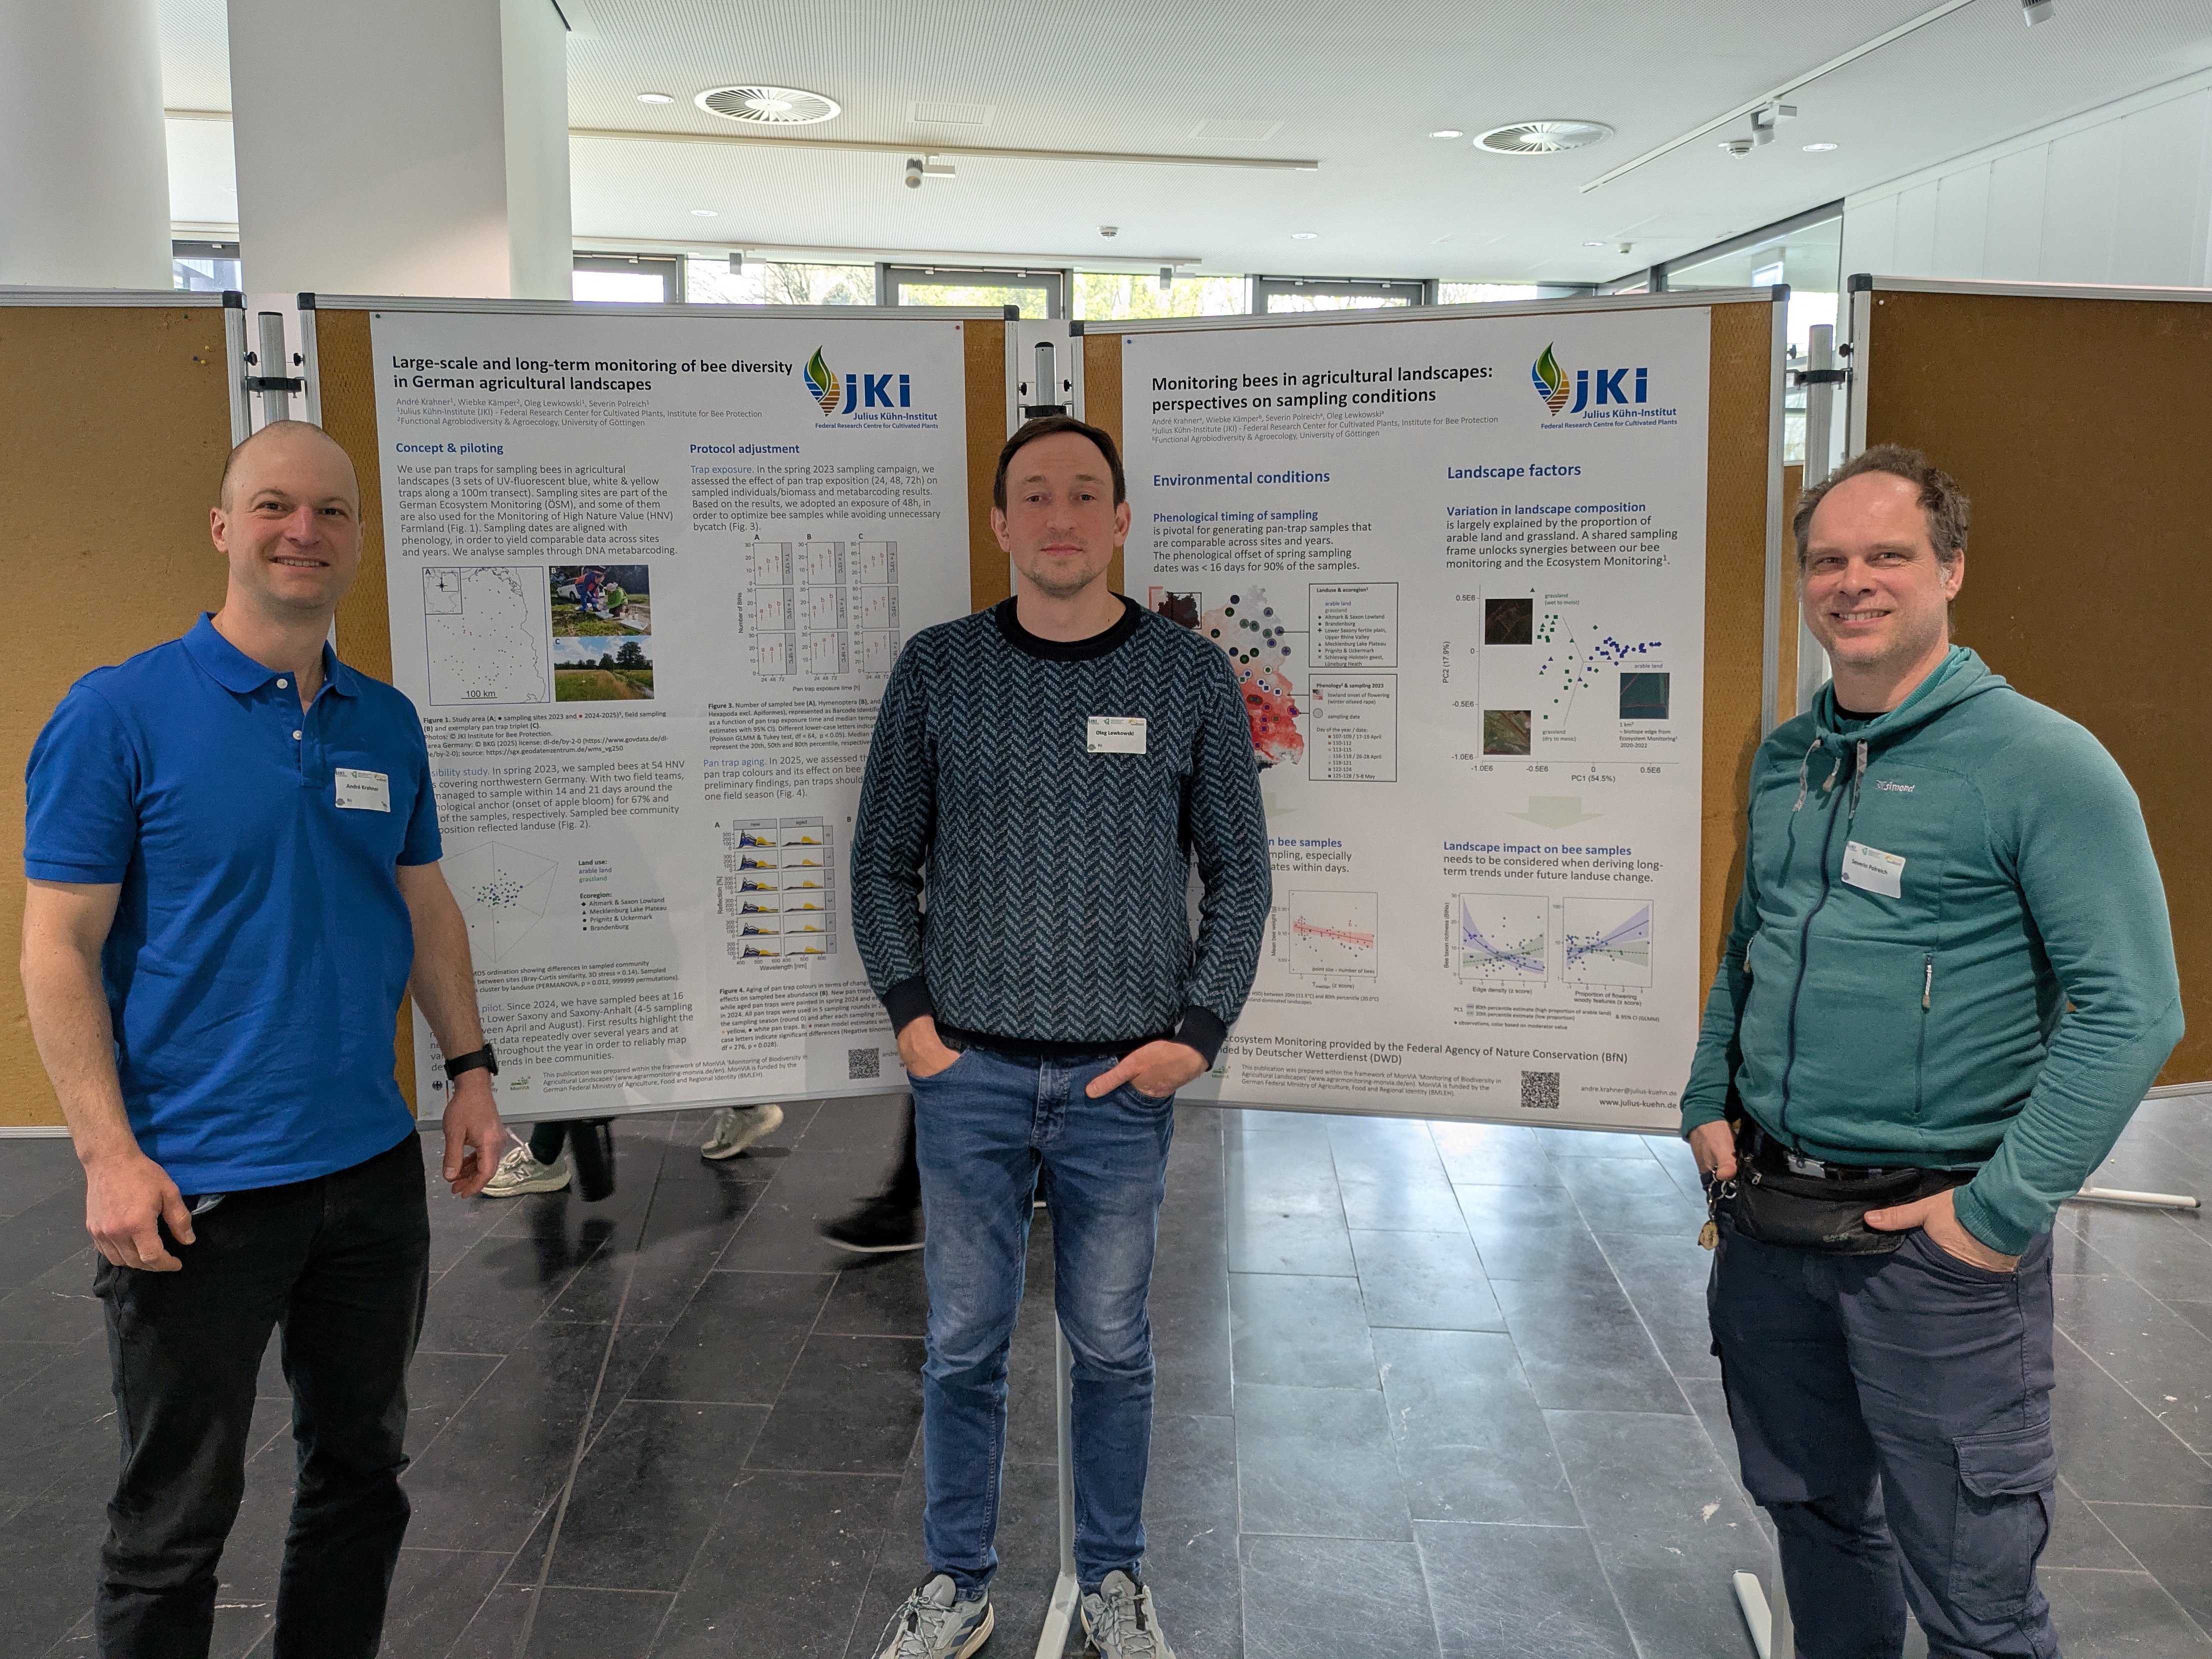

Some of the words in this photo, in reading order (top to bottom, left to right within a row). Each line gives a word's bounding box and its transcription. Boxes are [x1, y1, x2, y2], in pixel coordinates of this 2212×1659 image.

[393, 356, 478, 371] Large-scale
[484, 357, 510, 370] and
[516, 357, 590, 373] long-term
[596, 359, 676, 374] monitoring
[682, 360, 696, 372] of
[701, 360, 726, 372] bee
[732, 360, 792, 376] diversity
[394, 376, 407, 388] in
[413, 376, 474, 388] German
[480, 376, 565, 392] agricultural
[570, 377, 651, 393] landscapes
[1153, 376, 1238, 391] Monitoring
[1243, 374, 1278, 388] bees
[1284, 372, 1296, 386] in
[1302, 368, 1392, 388] agricultural
[1398, 367, 1492, 382] landscapes:
[1153, 396, 1247, 414] perspectives
[1252, 398, 1271, 408] on
[1277, 392, 1347, 408] sampling
[1352, 389, 1436, 404] conditions
[853, 412, 878, 420] Julius
[1582, 410, 1610, 418] Julius
[1613, 408, 1676, 418] Kühn-Institut
[396, 444, 444, 454] Concept
[448, 443, 456, 452] &
[460, 442, 503, 454] piloting
[690, 444, 734, 453] Protocol
[739, 444, 800, 455] adjustment
[398, 465, 412, 473] We
[434, 466, 451, 474] pan
[454, 466, 478, 475] traps
[481, 464, 494, 474] for
[496, 465, 537, 475] sampling
[540, 465, 562, 474] bees
[564, 466, 572, 474] in
[576, 465, 625, 476] agricultural
[690, 466, 710, 475] Trap
[712, 467, 754, 475] exposure.
[768, 465, 782, 474] the
[784, 466, 810, 475] spring
[814, 465, 834, 473] 2023
[837, 465, 874, 475] sampling
[877, 467, 919, 475] campaign,
[1448, 466, 1524, 480] Landscape
[1530, 464, 1580, 476] factors
[398, 476, 448, 486] landscapes
[452, 476, 460, 486] (3
[485, 477, 494, 486] of
[497, 477, 565, 486] UV-fluorescent
[568, 477, 590, 486] blue,
[593, 477, 618, 485] white
[621, 477, 628, 485] &
[630, 477, 658, 489] yellow
[1154, 472, 1252, 486] Environmental
[1257, 470, 1330, 484] conditions
[1447, 506, 1498, 516] Variation
[1502, 505, 1511, 514] in
[1516, 504, 1570, 516] landscape
[1575, 502, 1645, 514] composition
[1154, 512, 1218, 524] Phenological
[1221, 512, 1254, 522] timing
[1258, 510, 1268, 520] of
[1271, 510, 1318, 522] sampling
[1447, 520, 1454, 529] is
[1458, 520, 1490, 531] largely
[1494, 518, 1542, 530] explained
[1546, 518, 1558, 529] by
[1561, 518, 1577, 527] the
[1581, 517, 1636, 528] proportion
[1640, 516, 1651, 526] of
[1154, 526, 1160, 535] is
[1164, 526, 1194, 536] pivotal
[1197, 526, 1210, 534] for
[1213, 525, 1263, 536] generating
[1266, 525, 1306, 534] pan-trap
[1310, 522, 1348, 534] samples
[1352, 522, 1372, 531] that
[1442, 641, 1450, 667] (17.9%)
[1884, 782, 1916, 792] simond
[724, 791, 742, 800] field
[777, 790, 794, 799] (Fig.
[797, 789, 807, 798] 4).
[1444, 842, 1500, 854] Landscape
[1504, 843, 1540, 854] impact
[1562, 844, 1582, 854] bee
[1586, 846, 1631, 857] samples
[1444, 868, 1466, 876] term
[1470, 868, 1501, 877] trends
[1504, 870, 1534, 878] under
[1536, 870, 1568, 880] future
[1571, 870, 1610, 880] landuse
[1614, 872, 1652, 884] change.
[1276, 1036, 1326, 1048] Monitoring
[1330, 1040, 1370, 1050] provided
[1374, 1041, 1385, 1052] by
[1388, 1042, 1404, 1052] the
[1407, 1043, 1442, 1053] Federal
[1446, 1046, 1480, 1056] Agency
[1483, 1047, 1493, 1056] of
[1496, 1048, 1530, 1058] Nature
[1533, 1050, 1598, 1060] Conservation
[1602, 1052, 1627, 1064] (BfN)
[1600, 1100, 1676, 1109] www.julius-kuehn.de
